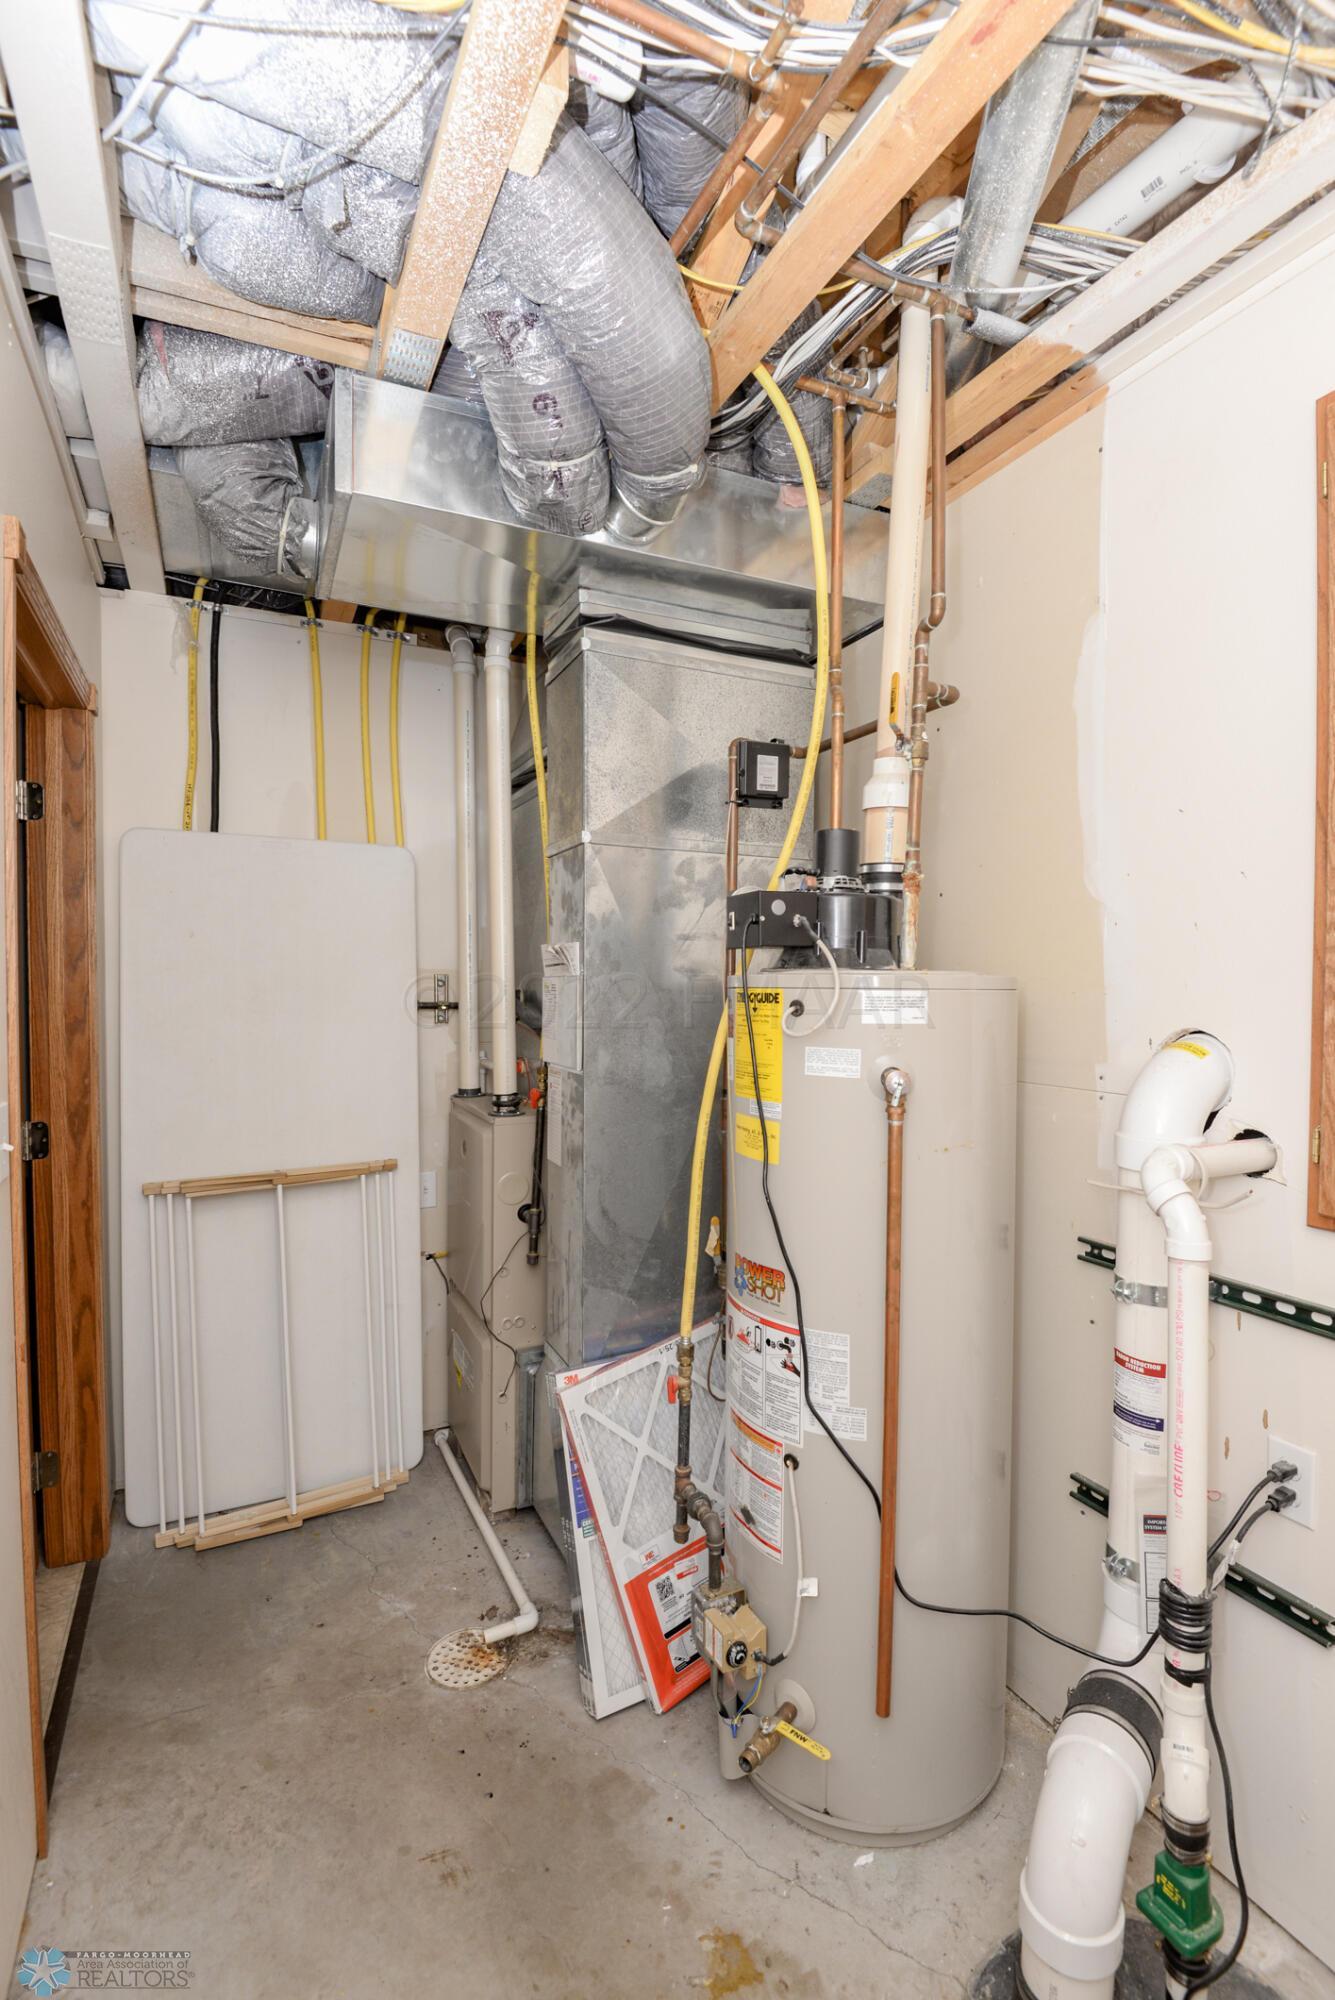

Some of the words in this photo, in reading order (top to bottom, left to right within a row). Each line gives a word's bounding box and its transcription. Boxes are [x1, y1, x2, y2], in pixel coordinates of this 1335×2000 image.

[735, 1252, 786, 1291] POWER
[747, 1276, 785, 1303] SHOT
[564, 1373, 579, 1386] 3M
